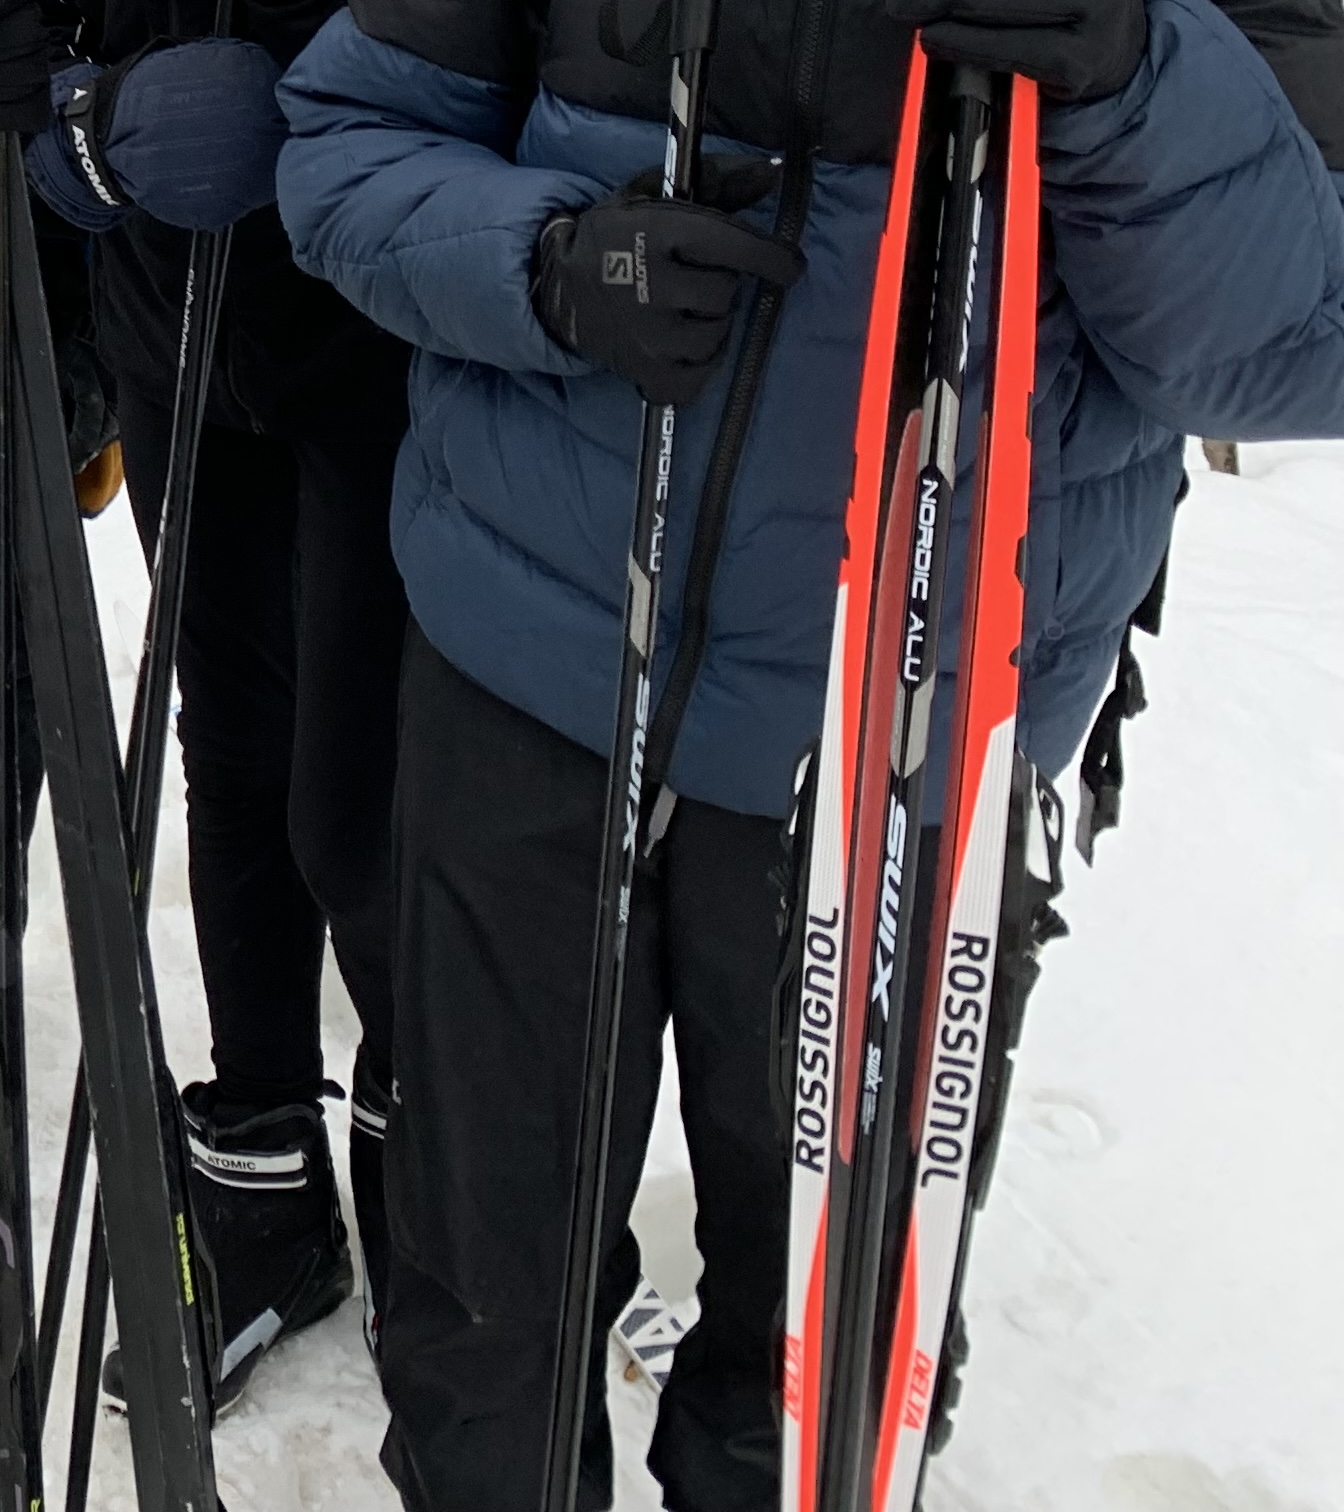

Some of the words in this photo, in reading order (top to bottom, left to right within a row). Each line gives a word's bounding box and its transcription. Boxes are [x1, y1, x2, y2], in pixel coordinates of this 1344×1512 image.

[913, 477, 941, 604] NORDIC
[904, 608, 925, 683] ALU
[871, 796, 908, 1023] SWIX
[794, 905, 840, 1175] ROSSIGNOL
[920, 930, 992, 1190] ROSSIGNOL
[208, 1155, 257, 1171] ATOMIC
[904, 1349, 934, 1431] DELTA
